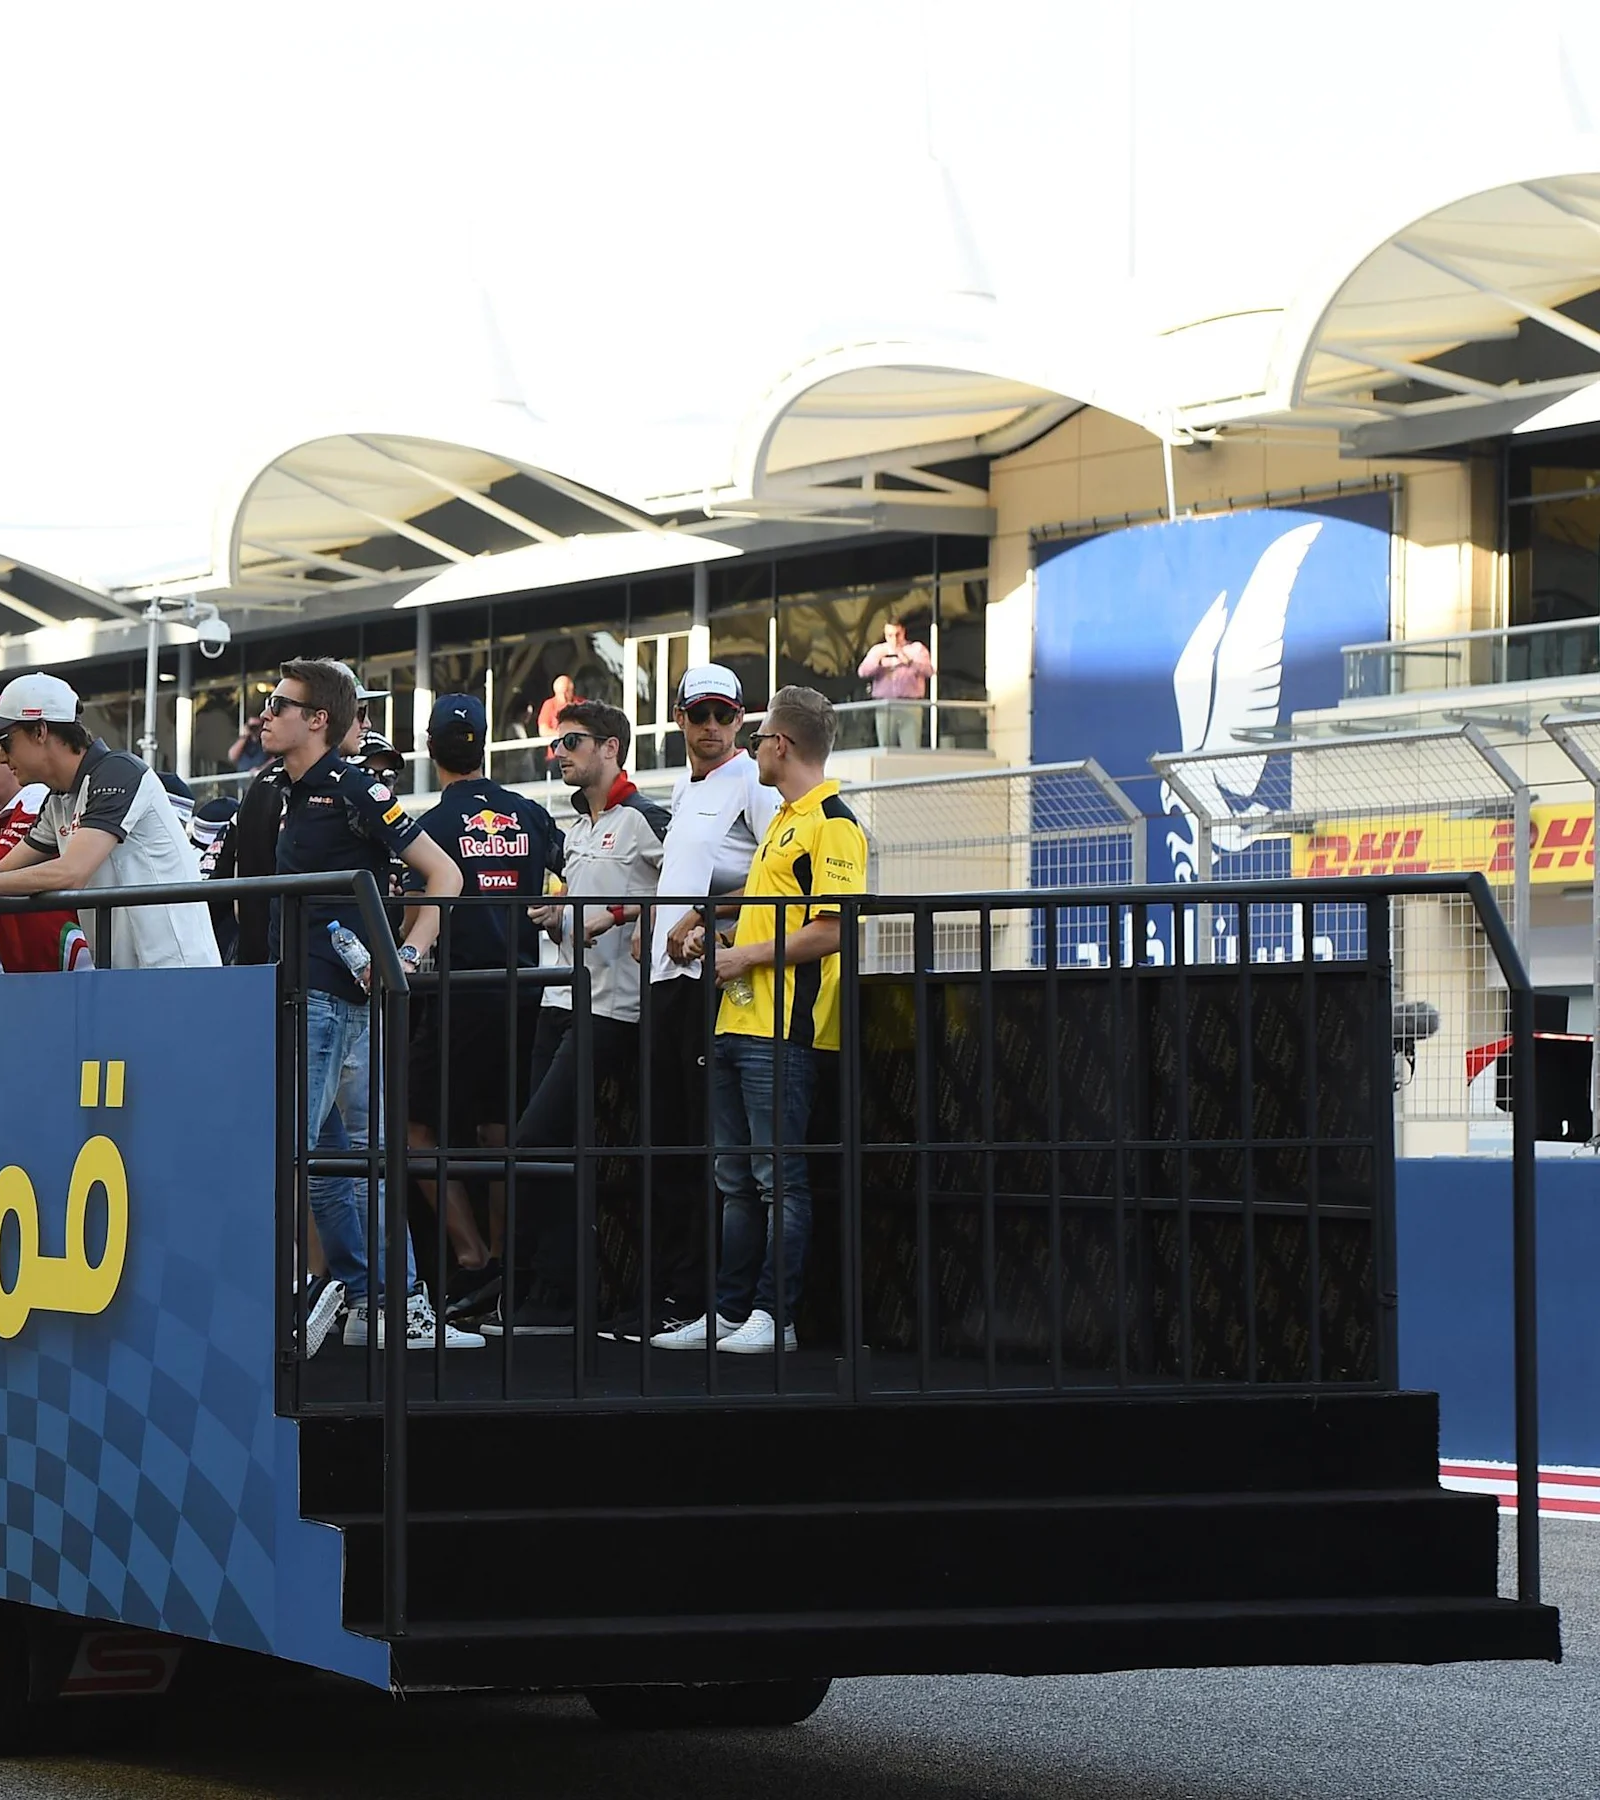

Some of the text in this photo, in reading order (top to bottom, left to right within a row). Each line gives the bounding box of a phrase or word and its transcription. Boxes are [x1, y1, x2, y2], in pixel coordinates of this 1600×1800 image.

[1306, 829, 1430, 878] DHL
[1488, 817, 1595, 872] DH
[478, 873, 517, 887] TOTAL
[825, 870, 852, 883] TOTAL
